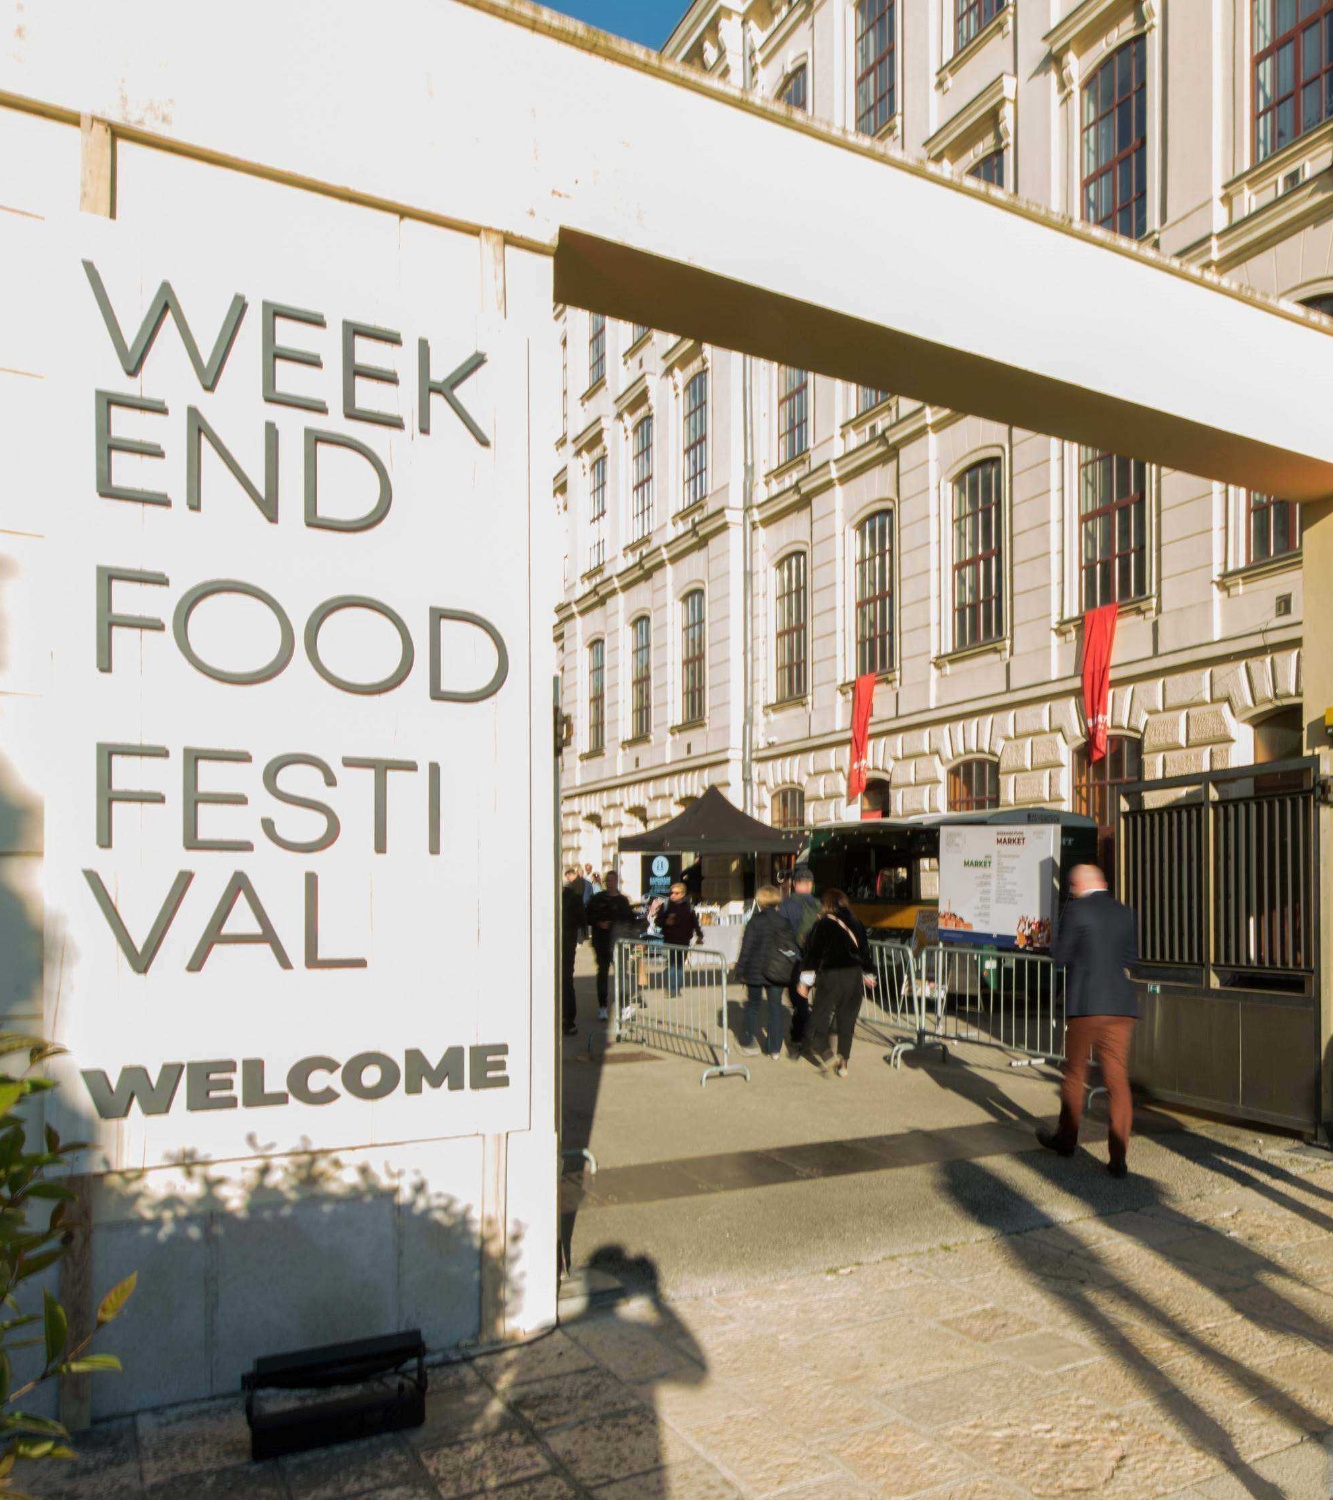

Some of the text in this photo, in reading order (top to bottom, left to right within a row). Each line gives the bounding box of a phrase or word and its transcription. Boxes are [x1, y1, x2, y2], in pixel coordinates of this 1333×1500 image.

[82, 258, 491, 447] WEEK
[94, 388, 392, 532] END
[95, 564, 509, 703] FOOD
[95, 741, 441, 855] FESTI
[996, 837, 1025, 845] MARKET
[963, 859, 992, 868] MARKET
[82, 868, 368, 974] VAL
[81, 1043, 510, 1120] WELCOME
